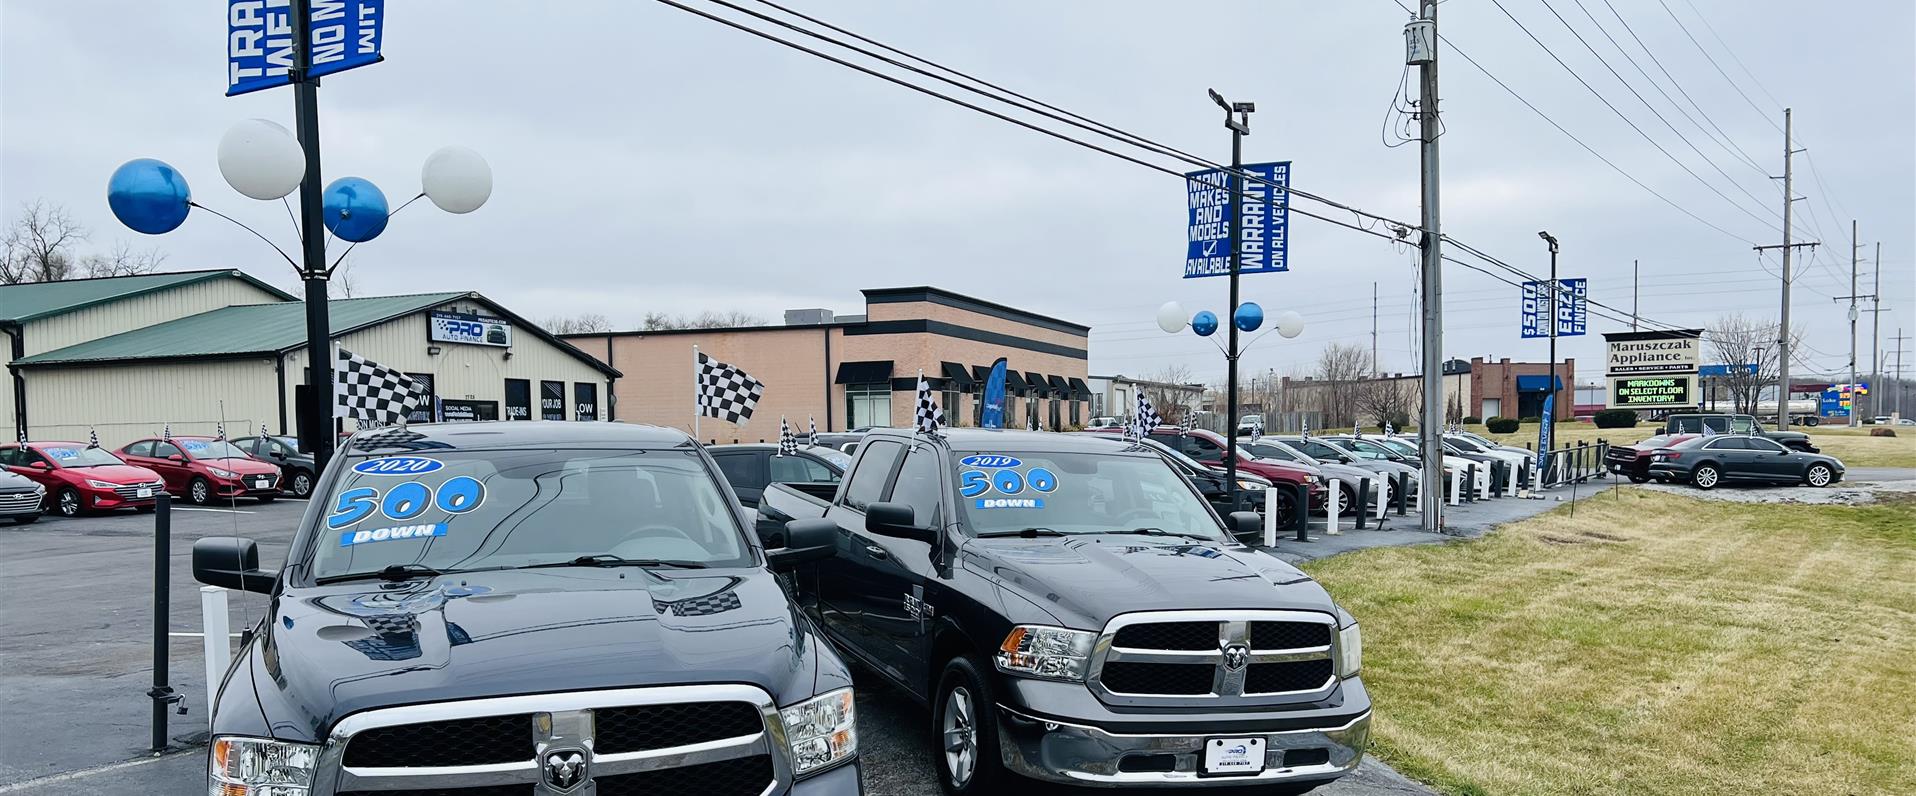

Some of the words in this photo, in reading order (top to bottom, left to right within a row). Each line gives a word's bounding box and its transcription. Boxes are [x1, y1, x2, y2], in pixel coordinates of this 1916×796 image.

[312, 25, 345, 65] NO
[1189, 172, 1228, 192] MANY
[1190, 188, 1229, 209] MAKES
[1196, 205, 1222, 224] AND
[1190, 221, 1229, 241] MODELS
[1272, 226, 1284, 248] ALL
[1186, 256, 1231, 275] AVAILABLE
[1272, 251, 1284, 268] ON
[1523, 284, 1537, 336] $500
[1574, 281, 1586, 333] FINANCE
[442, 333, 459, 341] AUTO
[460, 335, 484, 343] FINANCE
[446, 321, 483, 337] PRO
[1610, 339, 1692, 353] Maruszczak
[1610, 352, 1681, 365] Appliance
[1618, 388, 1629, 396] ON
[1630, 387, 1658, 395] SELECT
[1658, 386, 1684, 395] FLOOR
[1627, 379, 1675, 388] MARKDOWNS
[1627, 395, 1675, 403] INVENTORY!
[363, 459, 430, 472] 2020
[970, 456, 1013, 466] 2019
[959, 467, 1060, 499] 500
[327, 475, 488, 531] 500
[983, 499, 1036, 508] DOWN
[353, 523, 437, 544] DOWN
